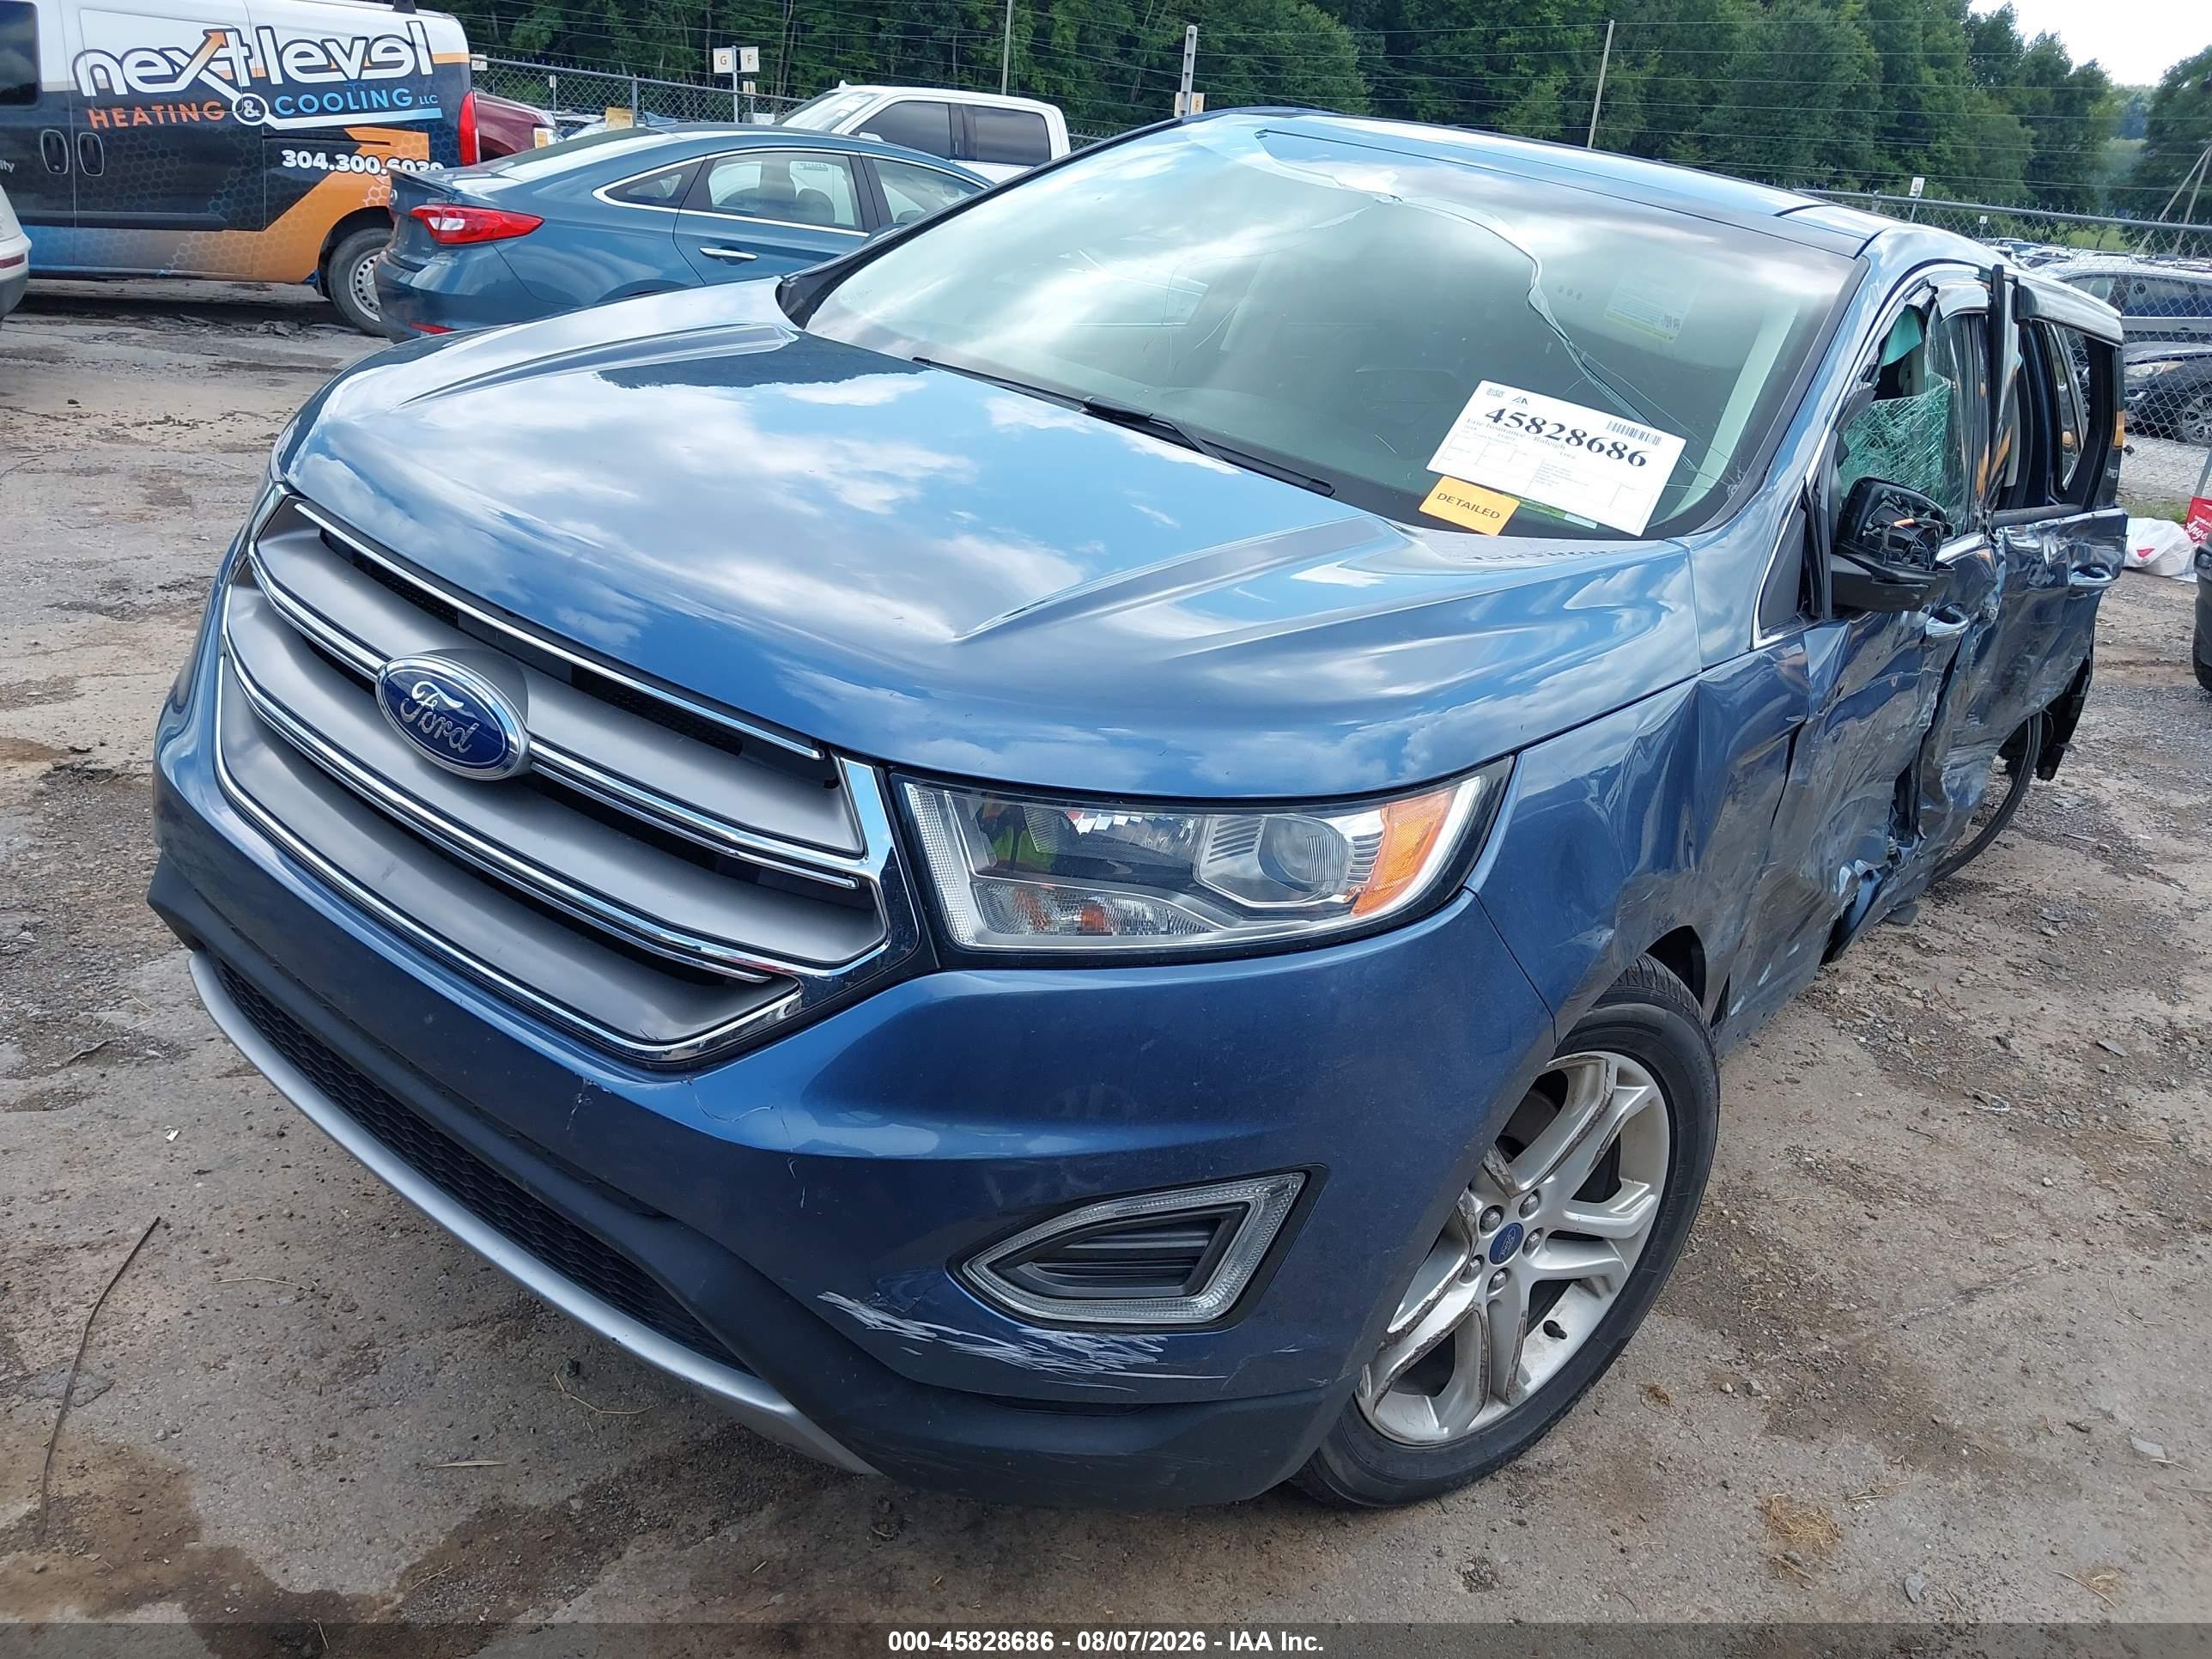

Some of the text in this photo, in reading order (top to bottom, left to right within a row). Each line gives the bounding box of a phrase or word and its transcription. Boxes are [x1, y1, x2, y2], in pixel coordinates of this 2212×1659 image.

[720, 55, 727, 65] G
[747, 54, 752, 64] F
[88, 88, 439, 129] HEATING & COOLING LLC
[1485, 408, 1650, 467] 45828686
[1436, 492, 1501, 520] DETAILED
[399, 680, 480, 754] Ford
